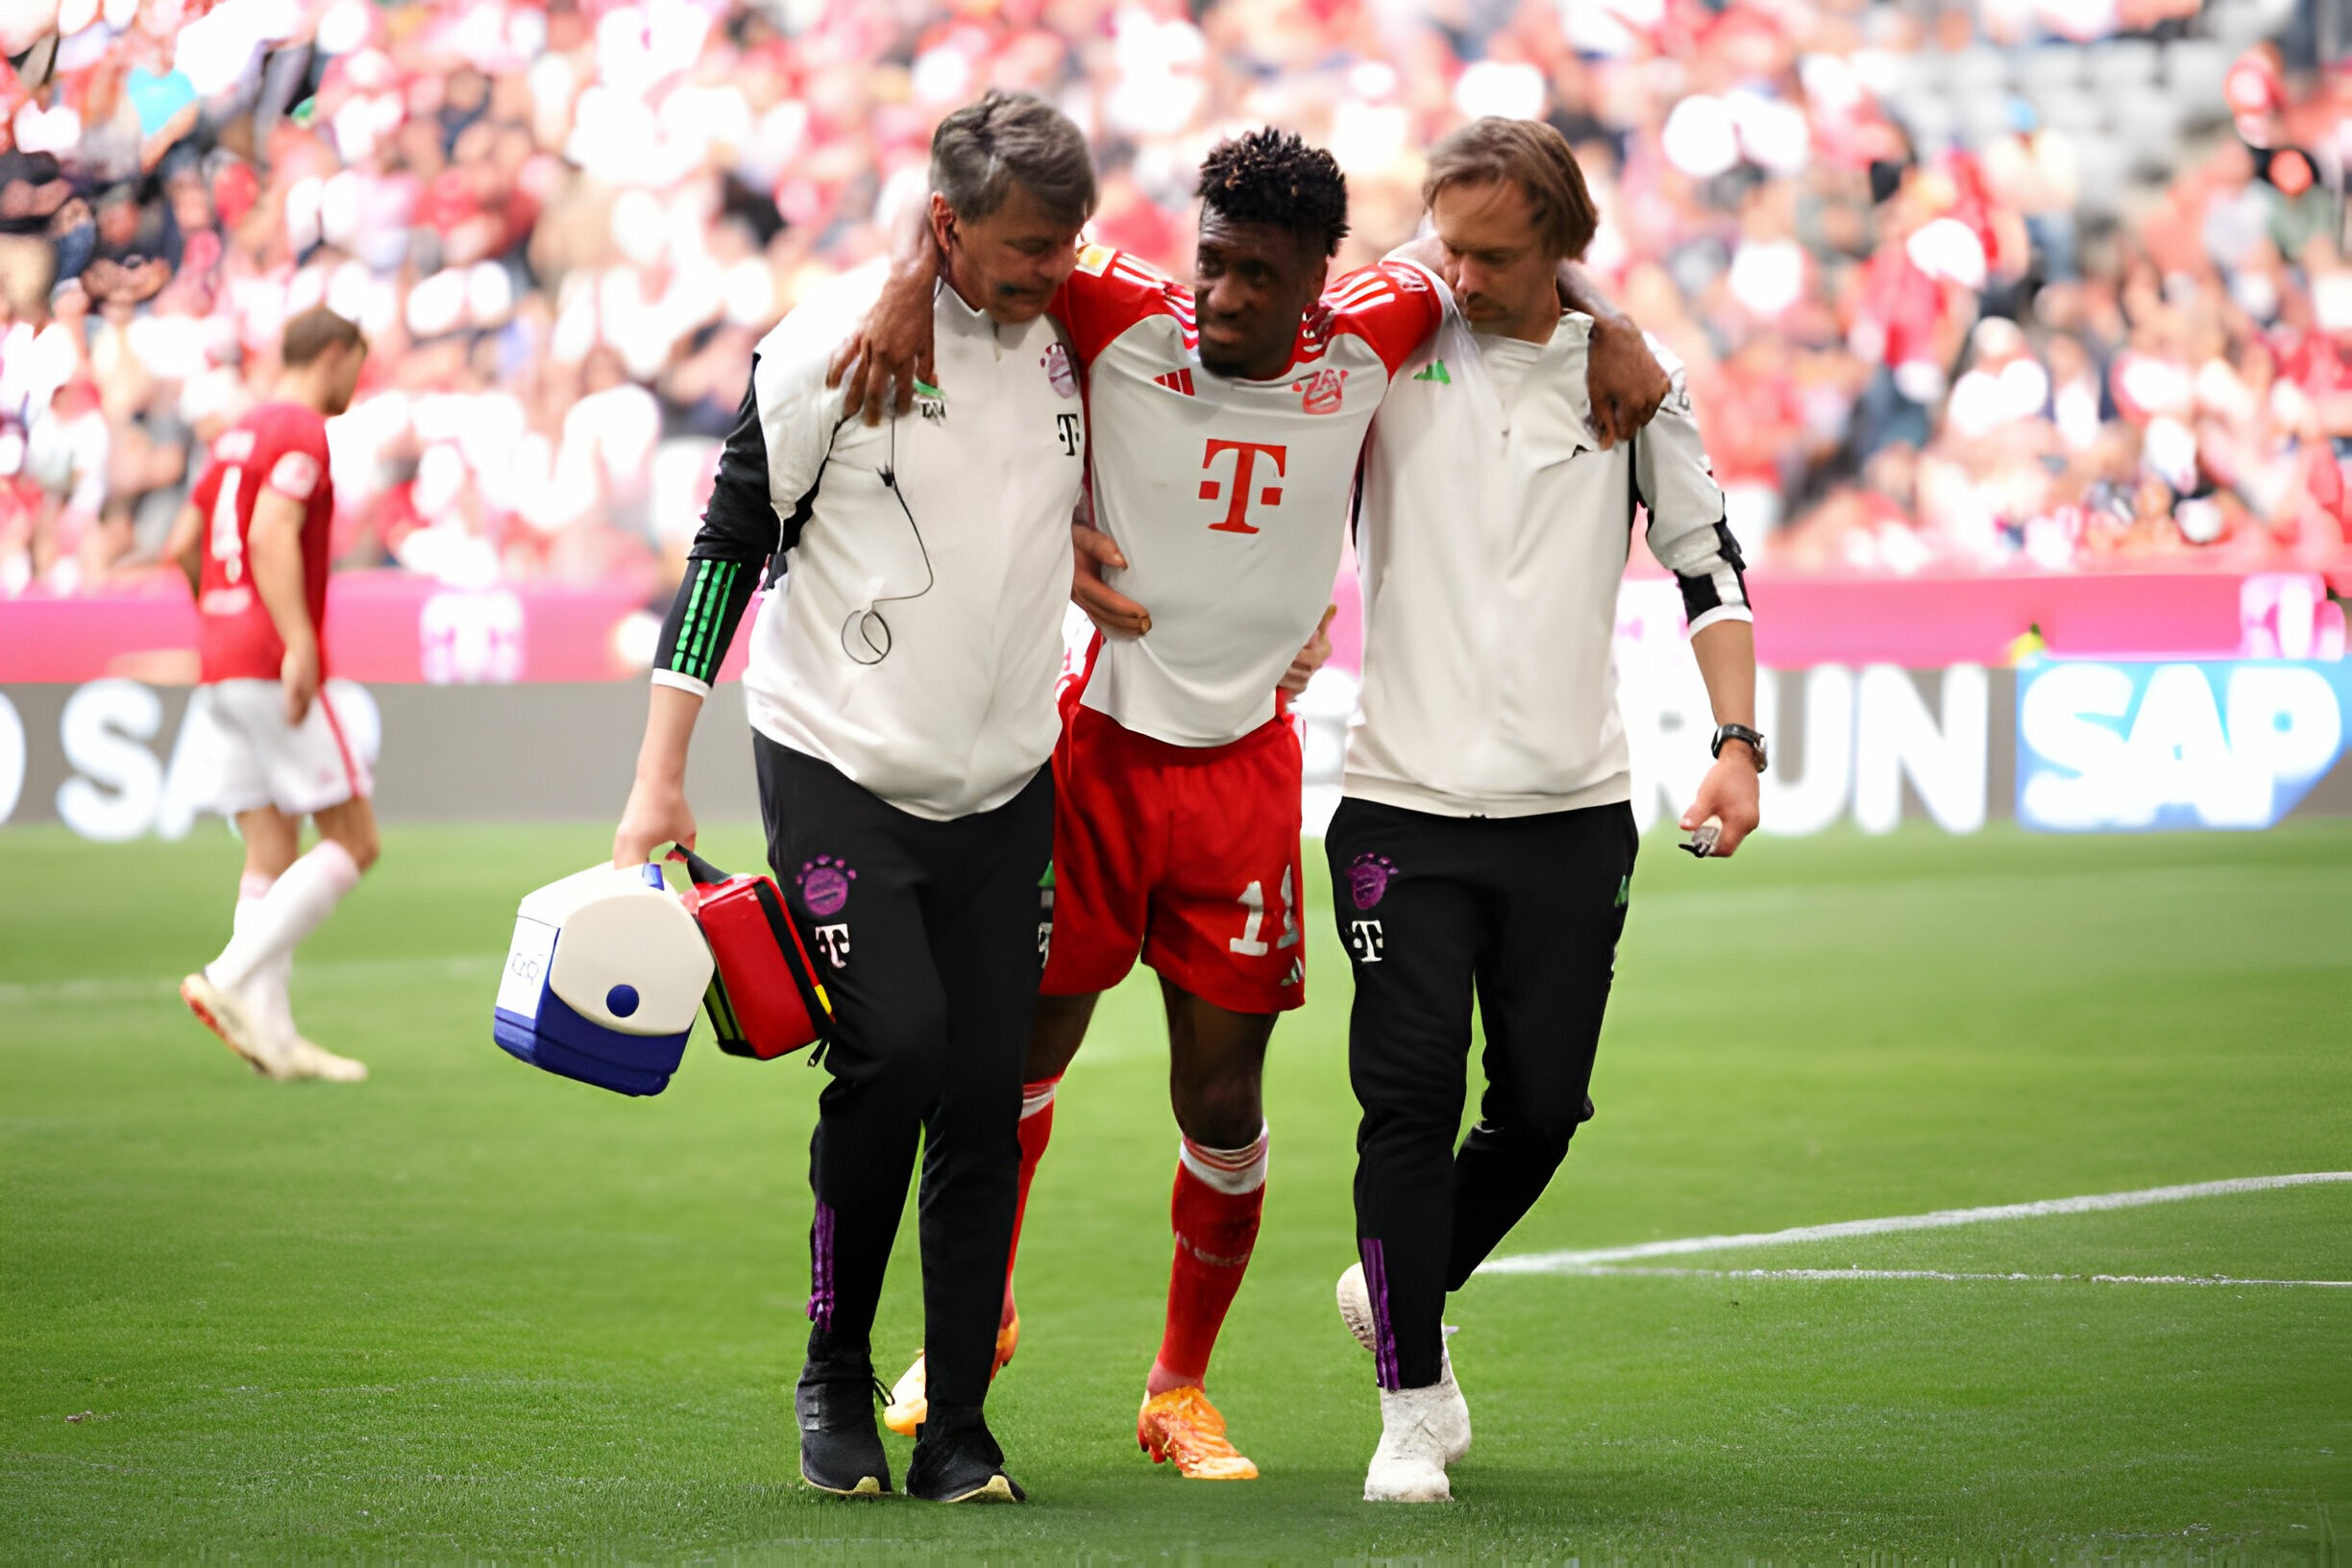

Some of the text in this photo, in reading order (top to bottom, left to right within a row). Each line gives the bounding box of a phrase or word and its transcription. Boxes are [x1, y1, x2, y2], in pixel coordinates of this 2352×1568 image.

[1056, 412, 1080, 456] T
[1198, 438, 1287, 534] T
[2021, 664, 2342, 830] SAP
[815, 923, 850, 968] T
[1351, 919, 1384, 963] T
